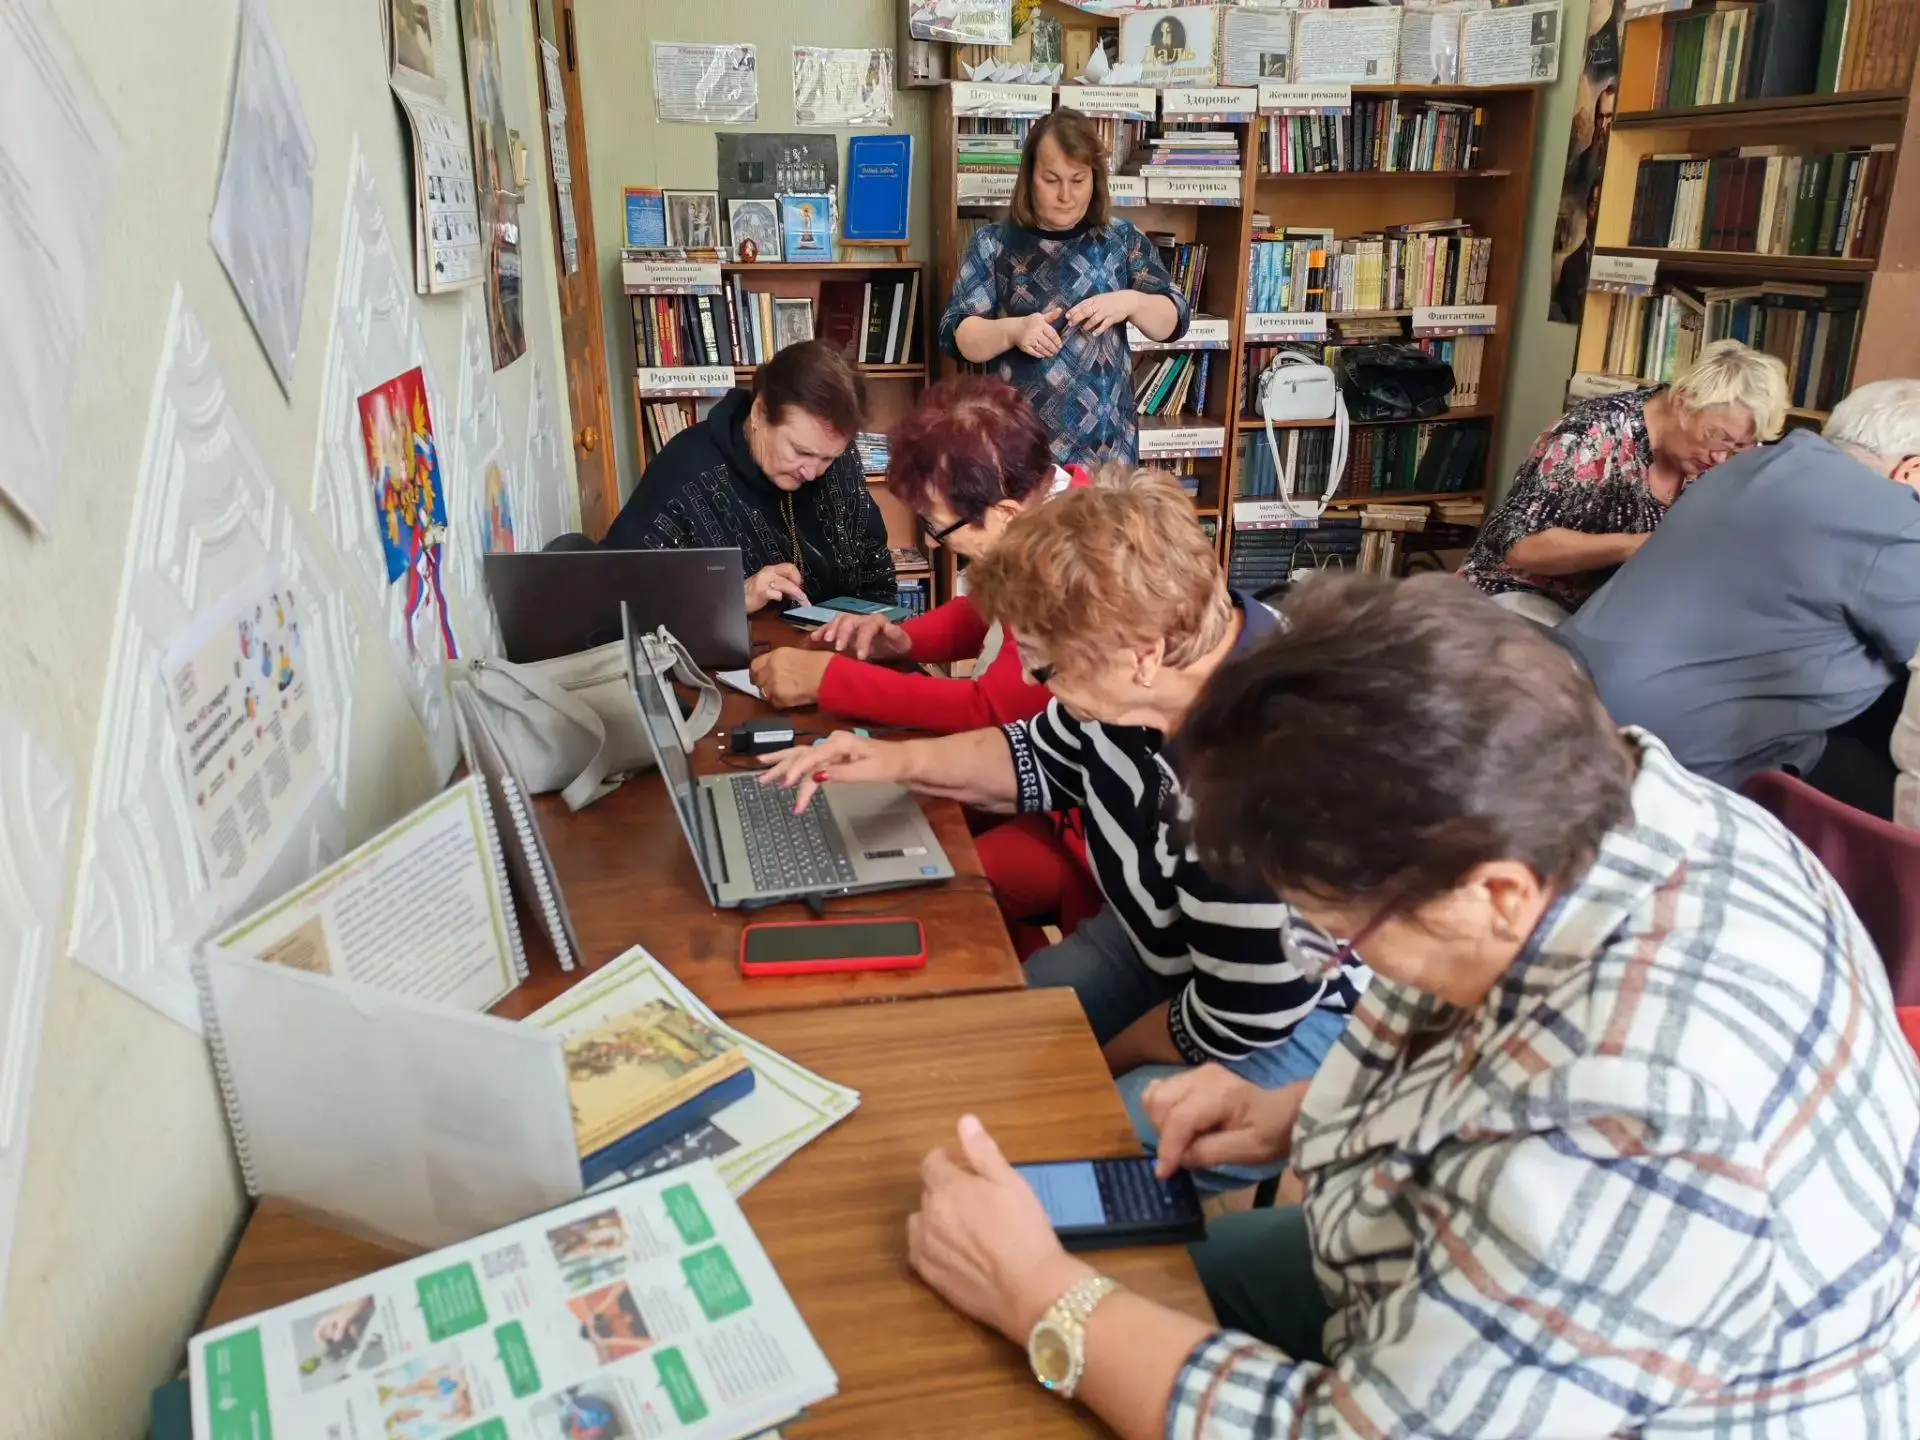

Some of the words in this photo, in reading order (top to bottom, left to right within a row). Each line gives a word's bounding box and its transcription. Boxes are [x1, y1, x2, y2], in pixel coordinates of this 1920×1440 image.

[1183, 93, 1241, 106] Здоровье
[1267, 91, 1309, 99] Женские
[1311, 92, 1348, 101] романы
[1167, 181, 1228, 193] Эзотерика
[1254, 315, 1315, 328] Детективы
[1427, 309, 1487, 322] Фантастика
[650, 372, 697, 384] Родной
[699, 372, 729, 384] край
